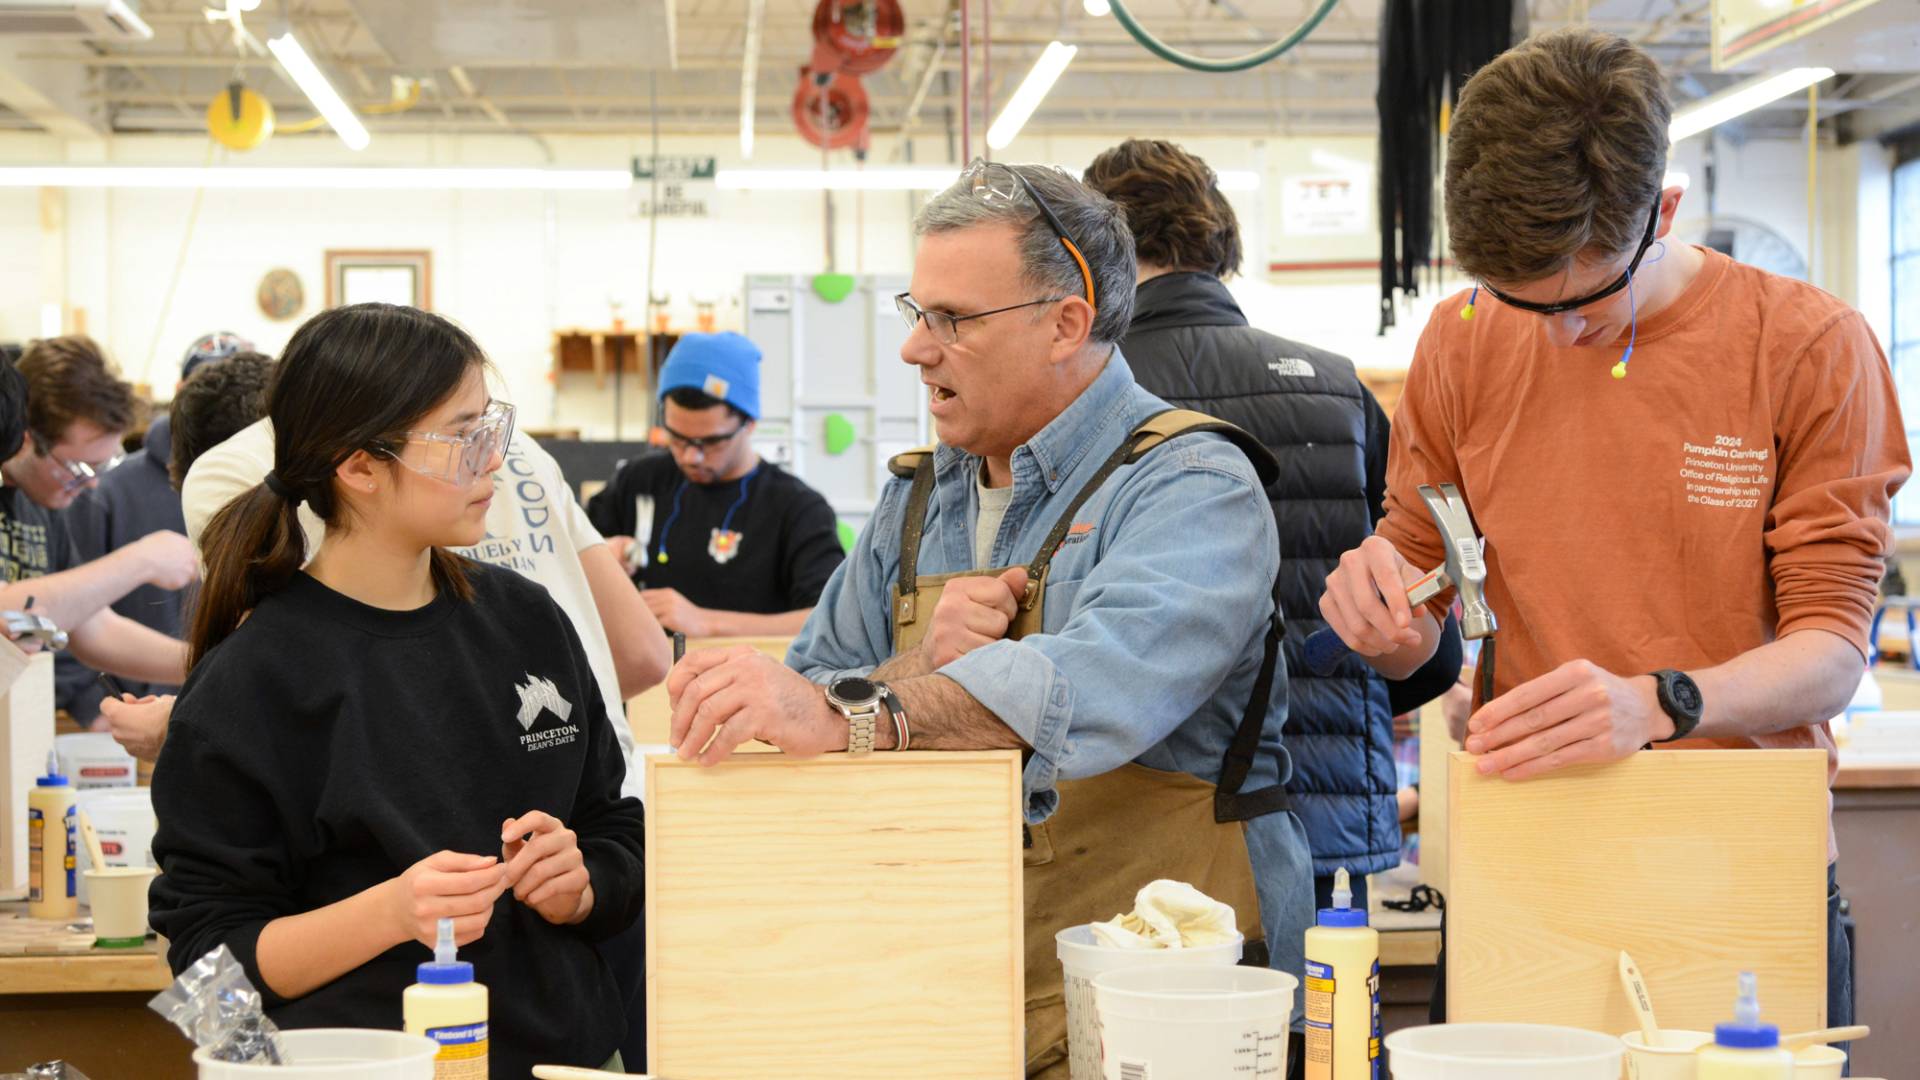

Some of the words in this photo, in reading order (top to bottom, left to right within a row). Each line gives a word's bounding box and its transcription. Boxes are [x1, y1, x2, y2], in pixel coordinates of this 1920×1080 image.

[1268, 362, 1297, 370] NORTH
[1279, 368, 1300, 376] FACE
[1715, 434, 1742, 447] 2024
[1683, 442, 1728, 457] Pumpkin
[1685, 457, 1725, 470] Princeton
[1680, 468, 1704, 479] Office
[1705, 472, 1716, 481] of
[1716, 473, 1751, 485] Religious
[1752, 474, 1769, 484] Life
[1686, 481, 1694, 490] in
[1694, 483, 1742, 497] partnership
[1742, 487, 1761, 497] with
[1687, 494, 1699, 504] the
[1700, 495, 1725, 507] Class
[1725, 498, 1735, 507] of
[1735, 499, 1758, 508] 2027
[555, 734, 576, 746] DATE
